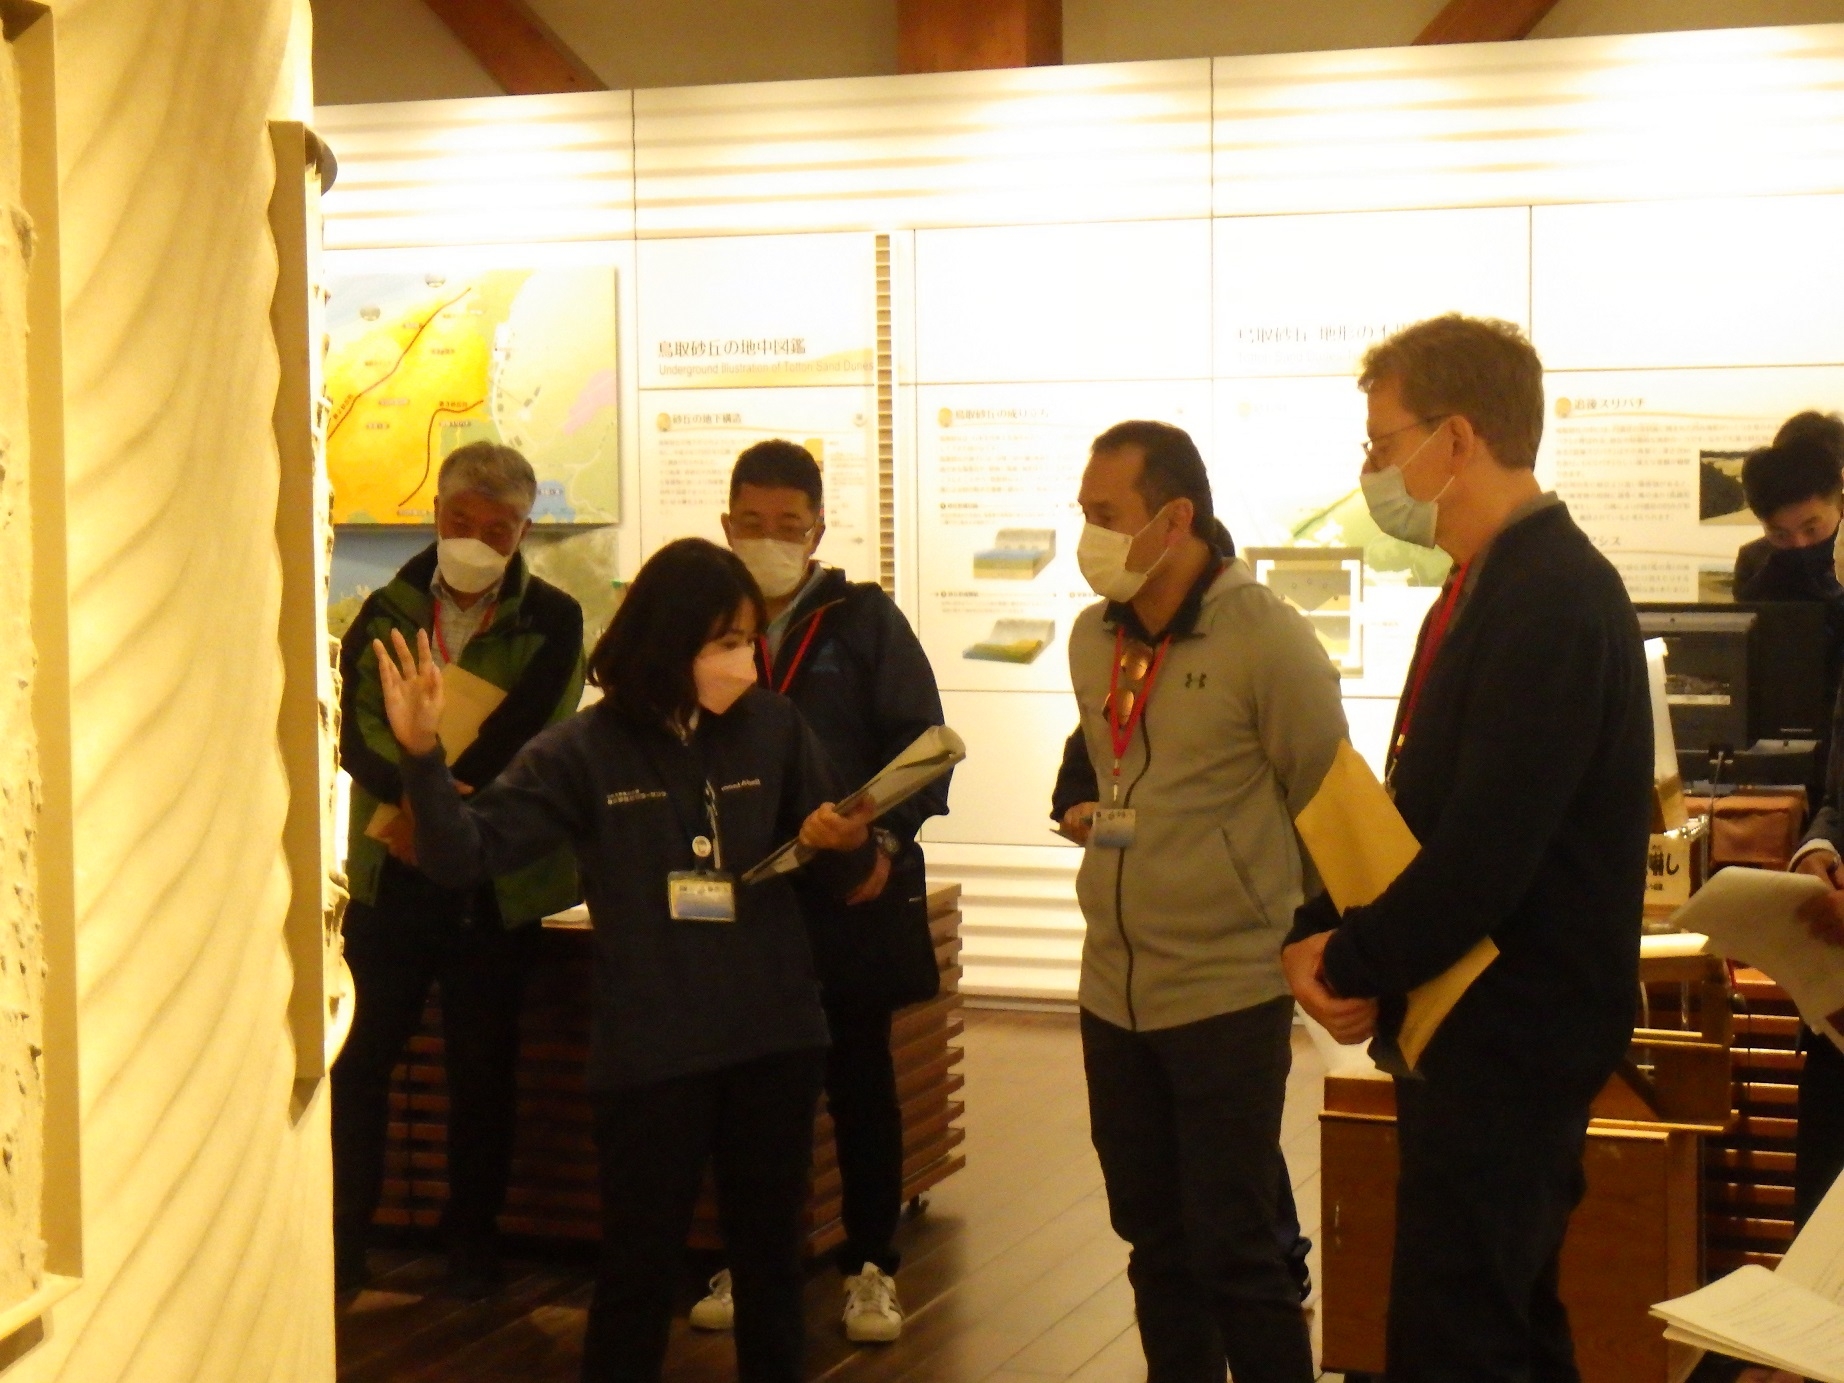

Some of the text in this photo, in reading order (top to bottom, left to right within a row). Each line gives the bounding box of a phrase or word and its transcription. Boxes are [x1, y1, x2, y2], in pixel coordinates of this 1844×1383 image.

[658, 338, 806, 358] 鳥取砂丘の地中図鑑
[659, 362, 719, 377] Underground
[721, 361, 769, 374] Illustration
[771, 361, 780, 373] of
[816, 359, 841, 373] Sand
[843, 358, 874, 372] Dunes
